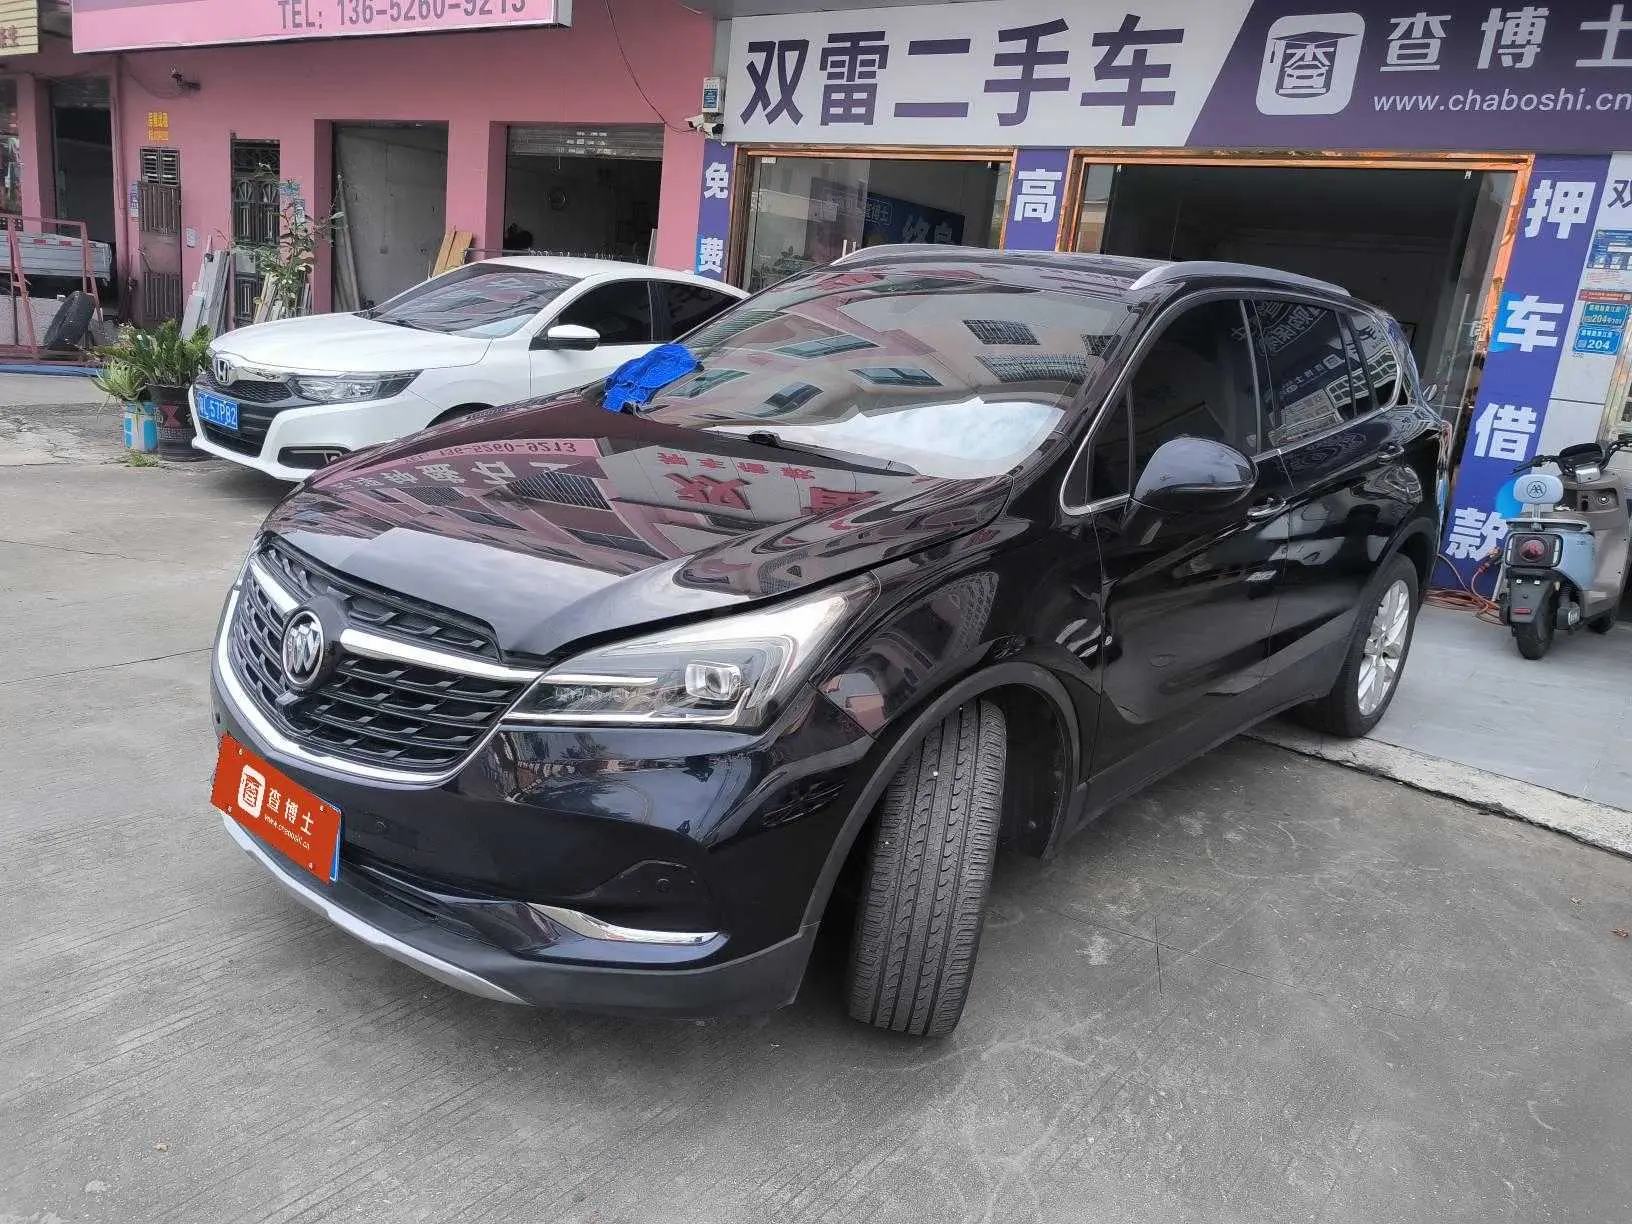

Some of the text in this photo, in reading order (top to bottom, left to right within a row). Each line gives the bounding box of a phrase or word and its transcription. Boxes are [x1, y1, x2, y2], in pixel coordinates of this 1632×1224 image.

[1379, 3, 1632, 72] 查博士
[739, 14, 1185, 127] 双雷二手车
[1373, 87, 1632, 113] www.chaboshi.cn
[1013, 167, 1063, 225] 高
[1587, 338, 1610, 350] 204
[266, 787, 314, 836] 查博士
